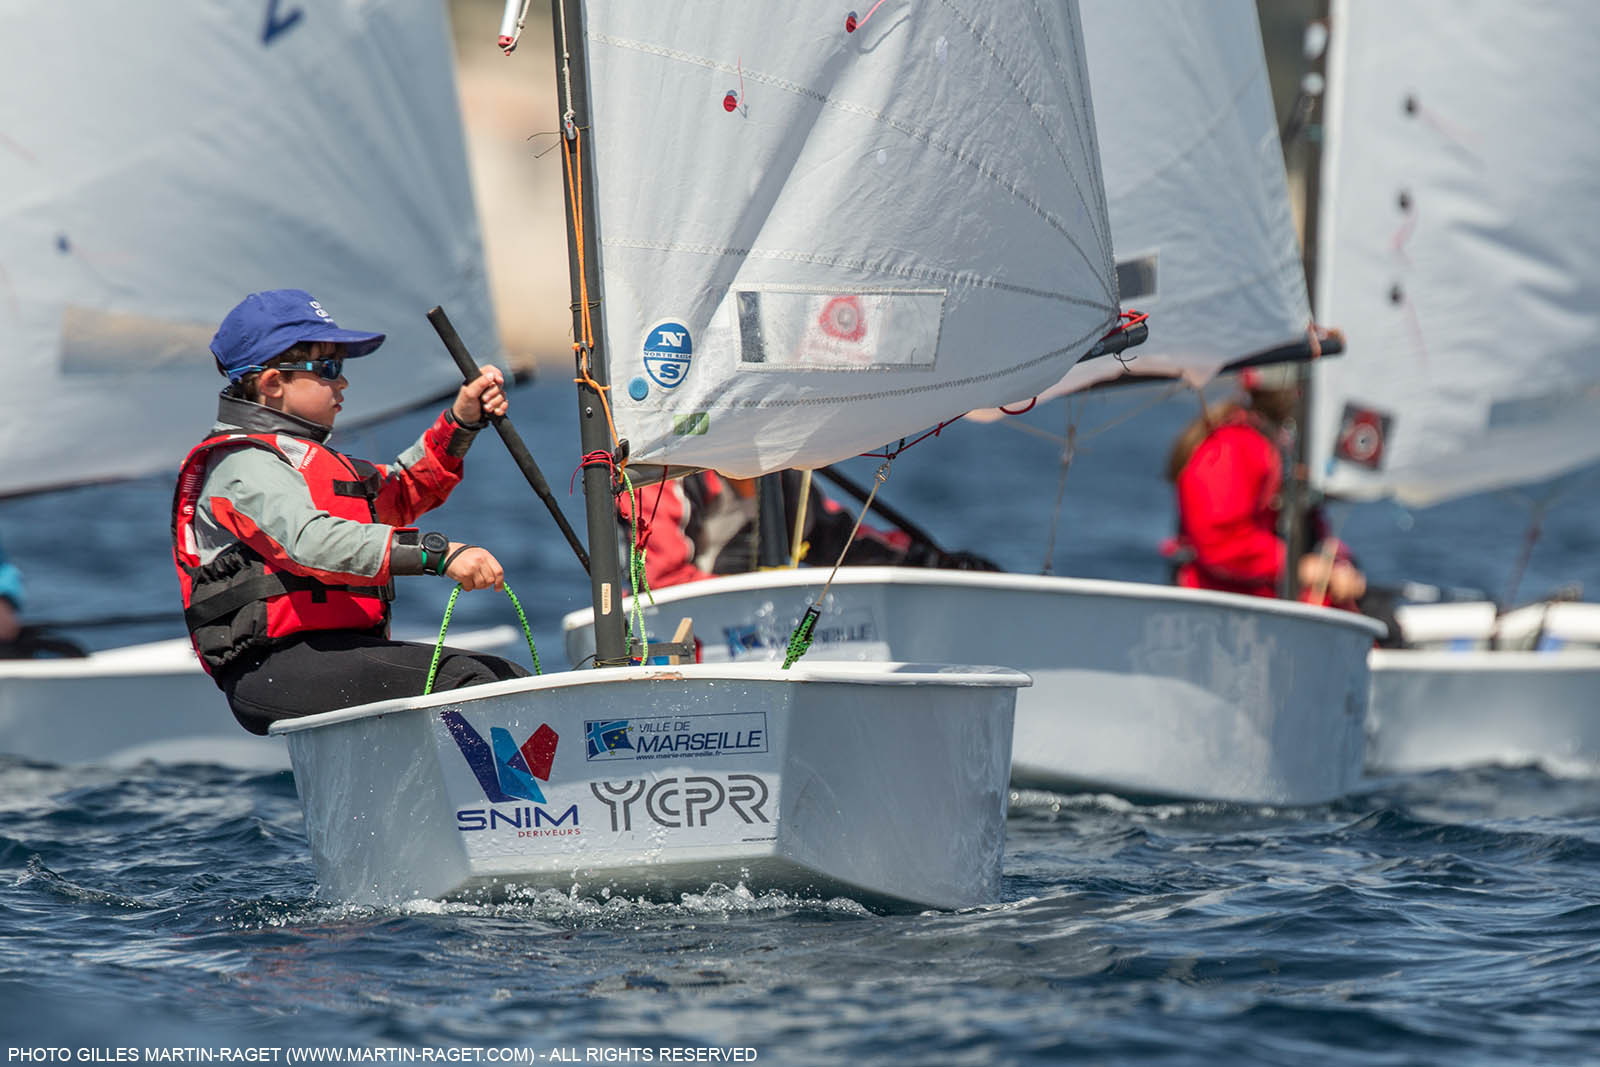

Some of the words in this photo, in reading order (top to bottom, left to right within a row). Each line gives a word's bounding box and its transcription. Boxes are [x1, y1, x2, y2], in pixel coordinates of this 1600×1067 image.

[658, 331, 686, 347] N
[659, 363, 681, 379] S
[639, 721, 671, 733] VILLE
[674, 721, 690, 731] DE
[636, 730, 762, 753] MARSEILLE
[636, 750, 722, 761] www.mairie-marseille.fr
[590, 774, 770, 832] YCPR
[456, 804, 579, 831] SNIM
[517, 828, 581, 838] DERIVEURS
